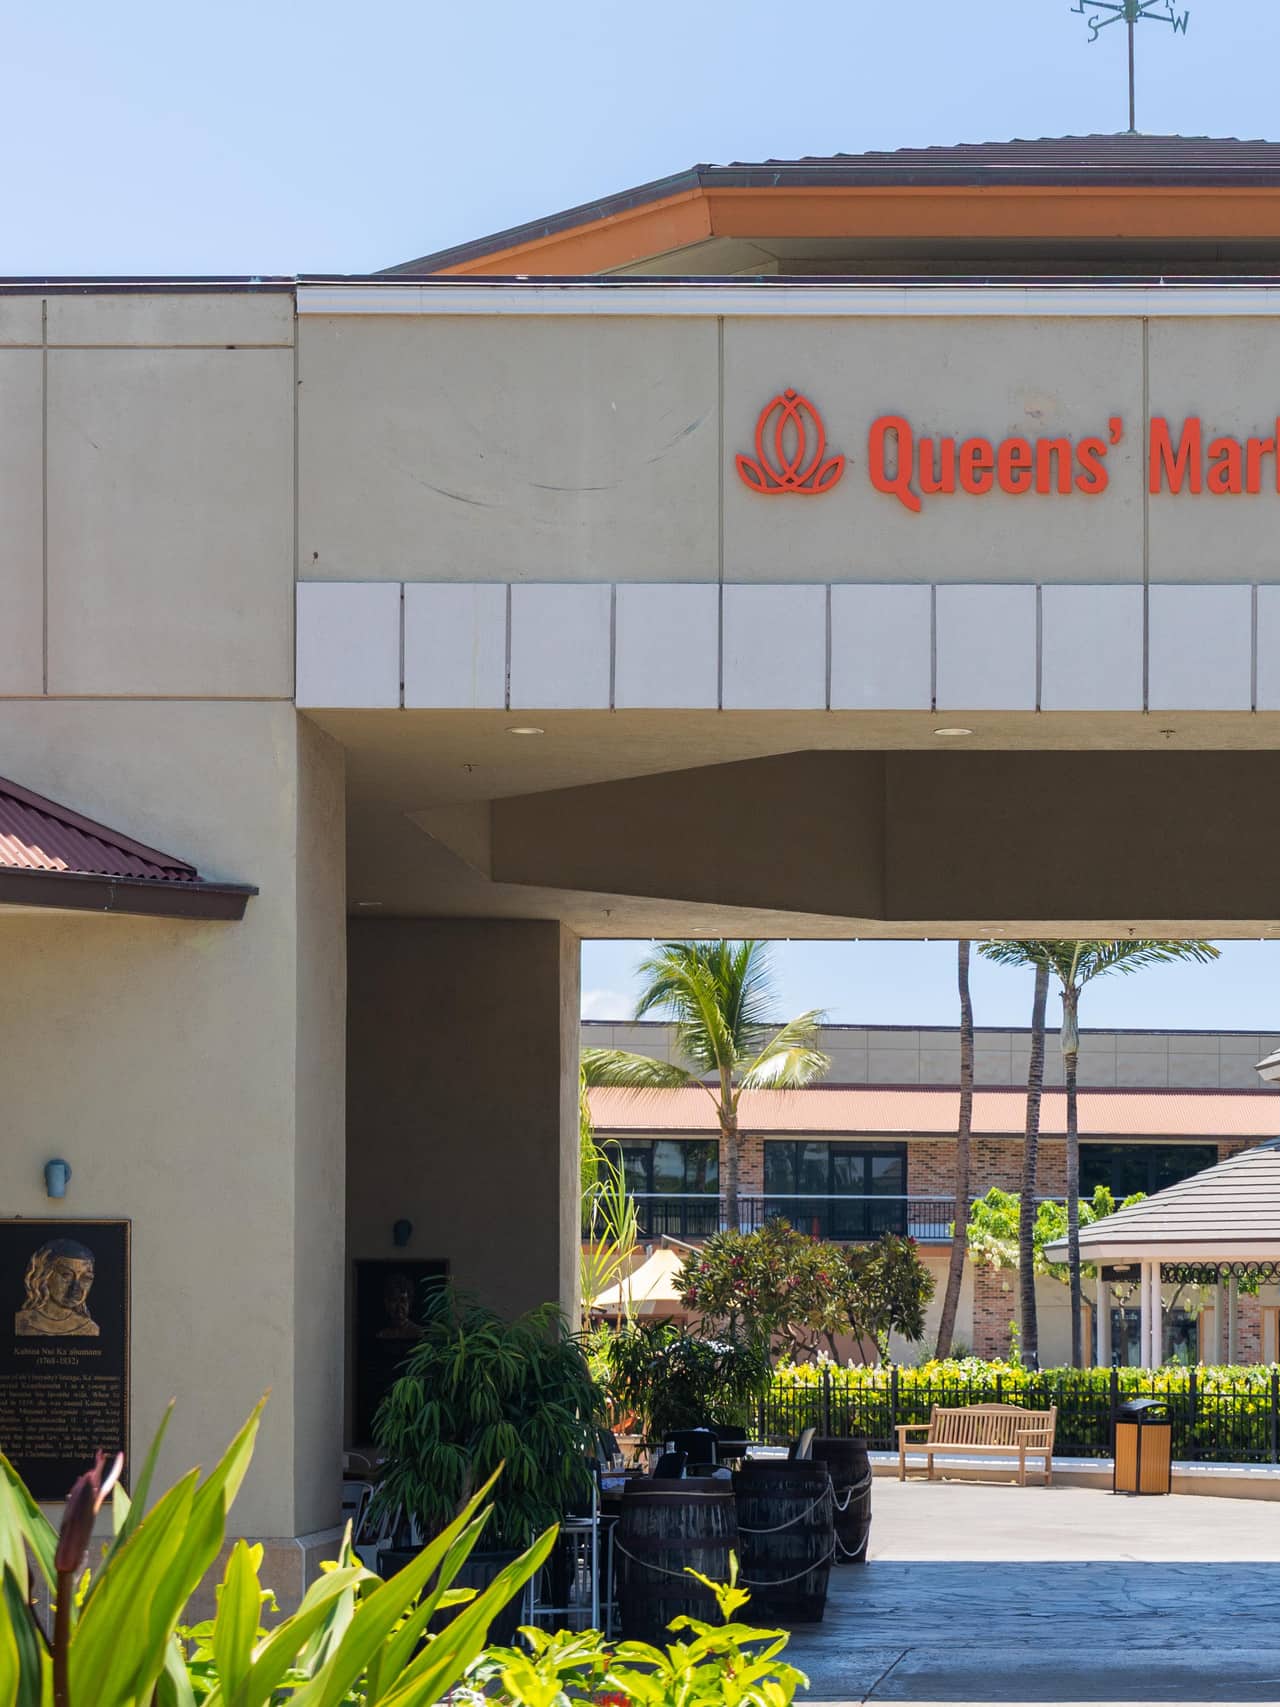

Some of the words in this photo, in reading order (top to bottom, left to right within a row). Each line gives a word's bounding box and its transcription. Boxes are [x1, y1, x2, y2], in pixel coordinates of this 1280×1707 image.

[1087, 14, 1100, 43] S
[1169, 8, 1190, 36] W
[867, 415, 1124, 514] Queens’
